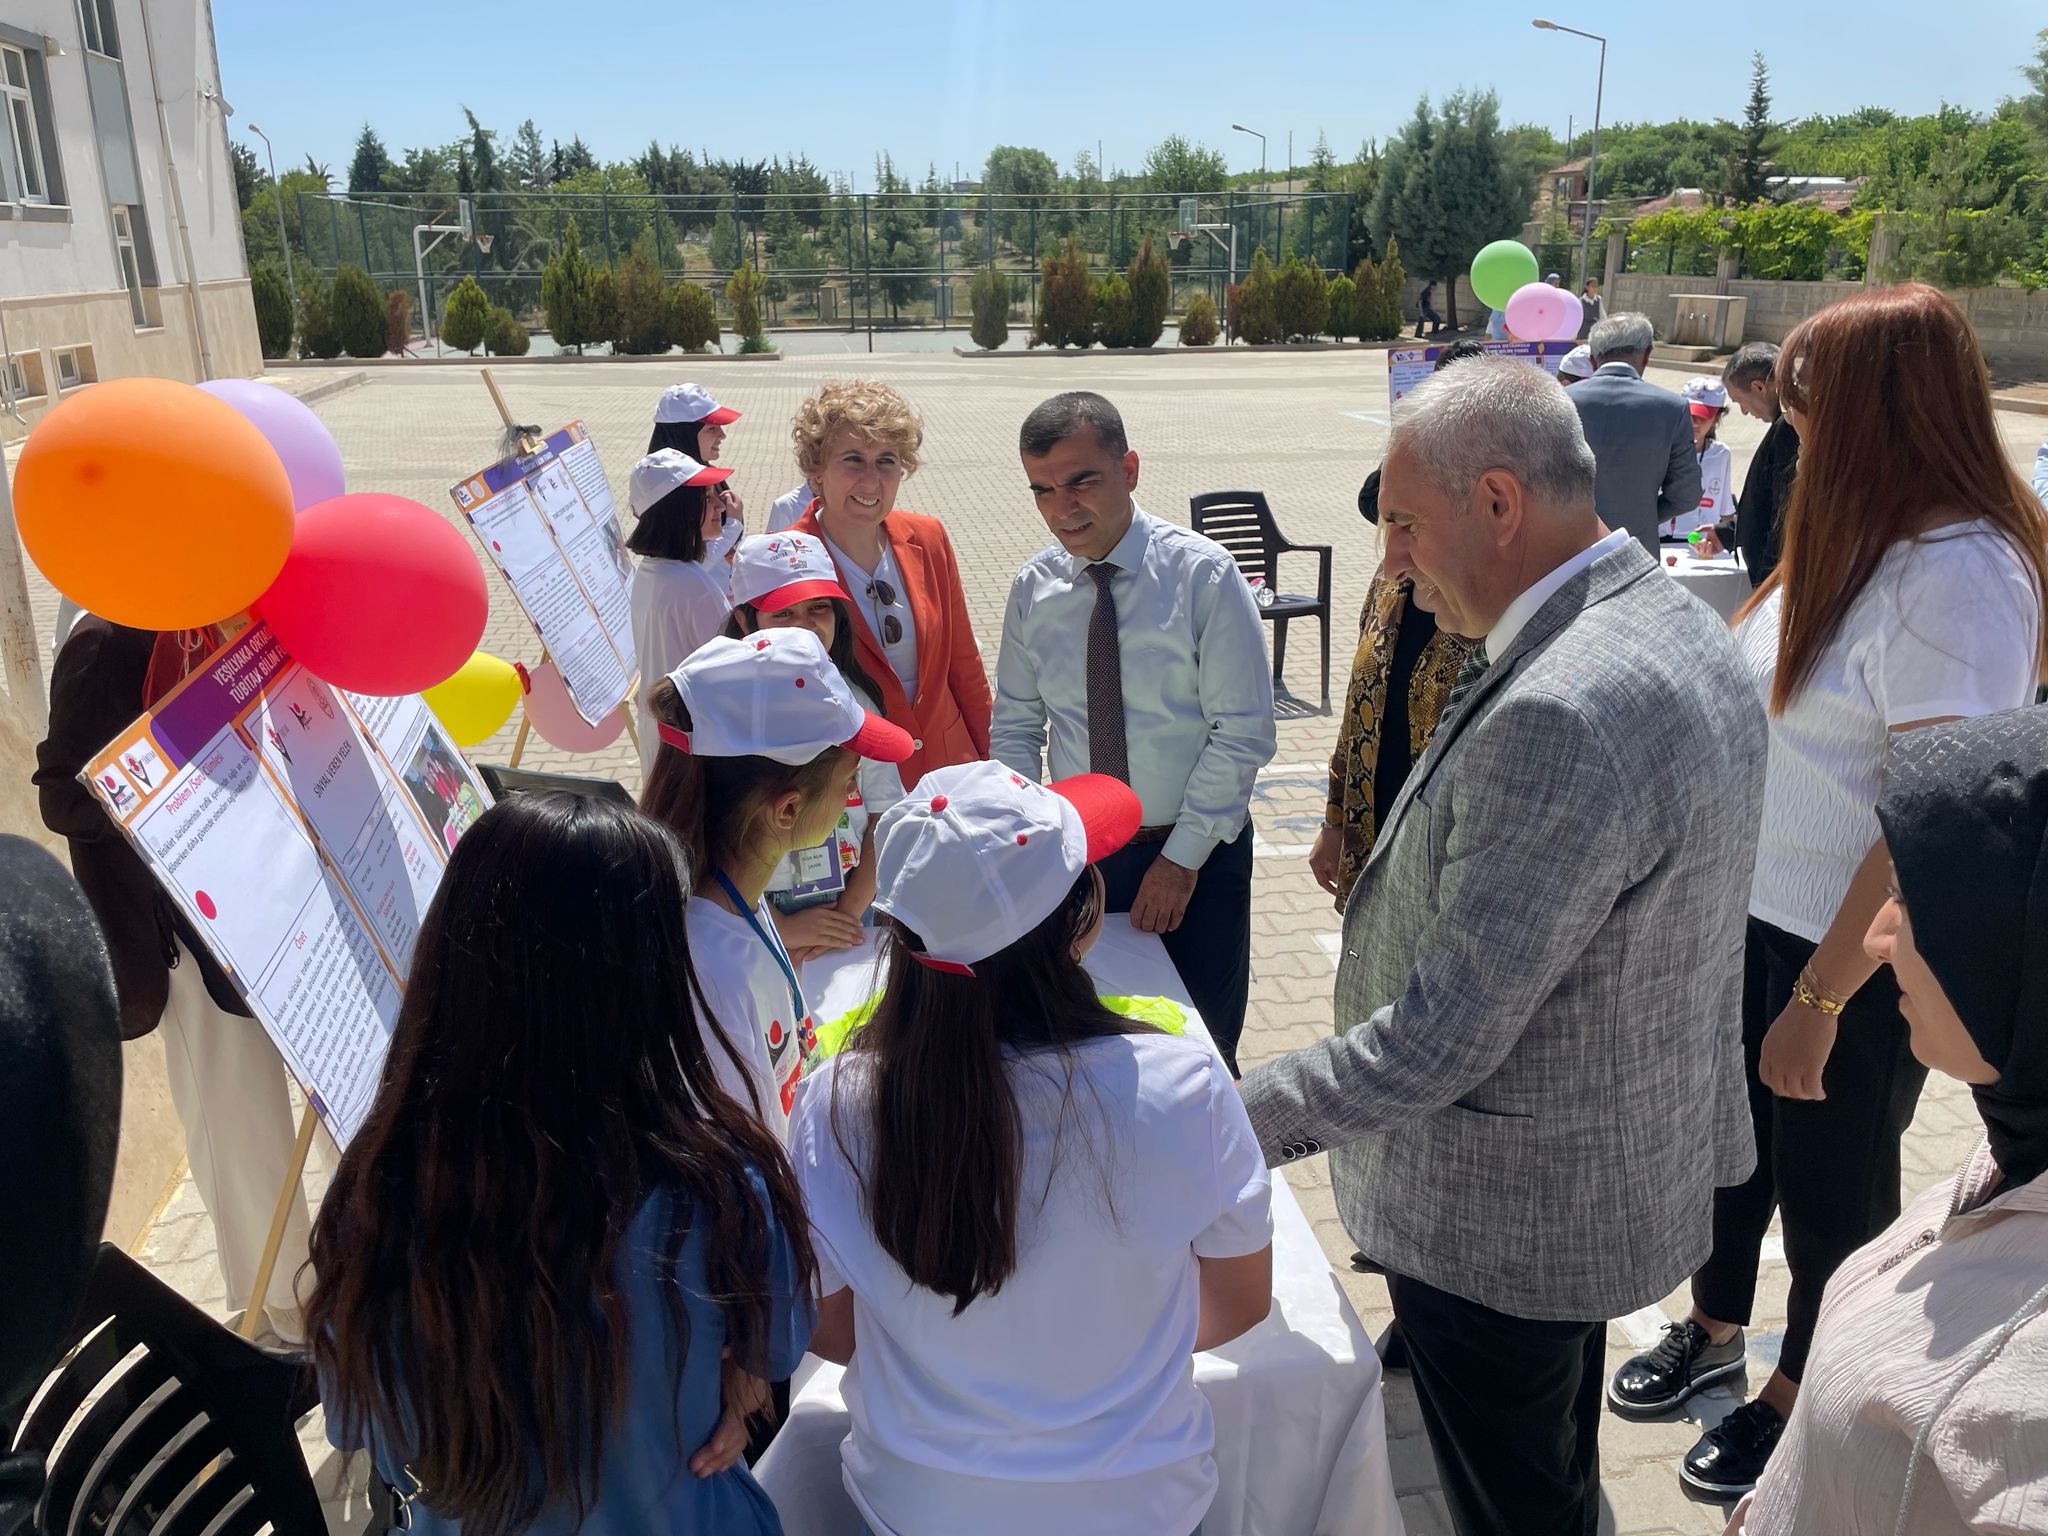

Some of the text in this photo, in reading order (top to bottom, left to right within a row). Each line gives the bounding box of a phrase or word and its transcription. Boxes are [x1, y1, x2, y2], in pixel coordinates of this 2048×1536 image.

[212, 626, 273, 686] YEŞİLYAKA ORTAO
[229, 667, 263, 704] TÜBİTAK
[258, 650, 280, 676] BİLİM
[327, 754, 343, 778] VEREN
[339, 740, 352, 761] YELEK
[165, 783, 192, 816] Problem
[157, 836, 176, 859] Bisiklet
[186, 834, 199, 851] daha
